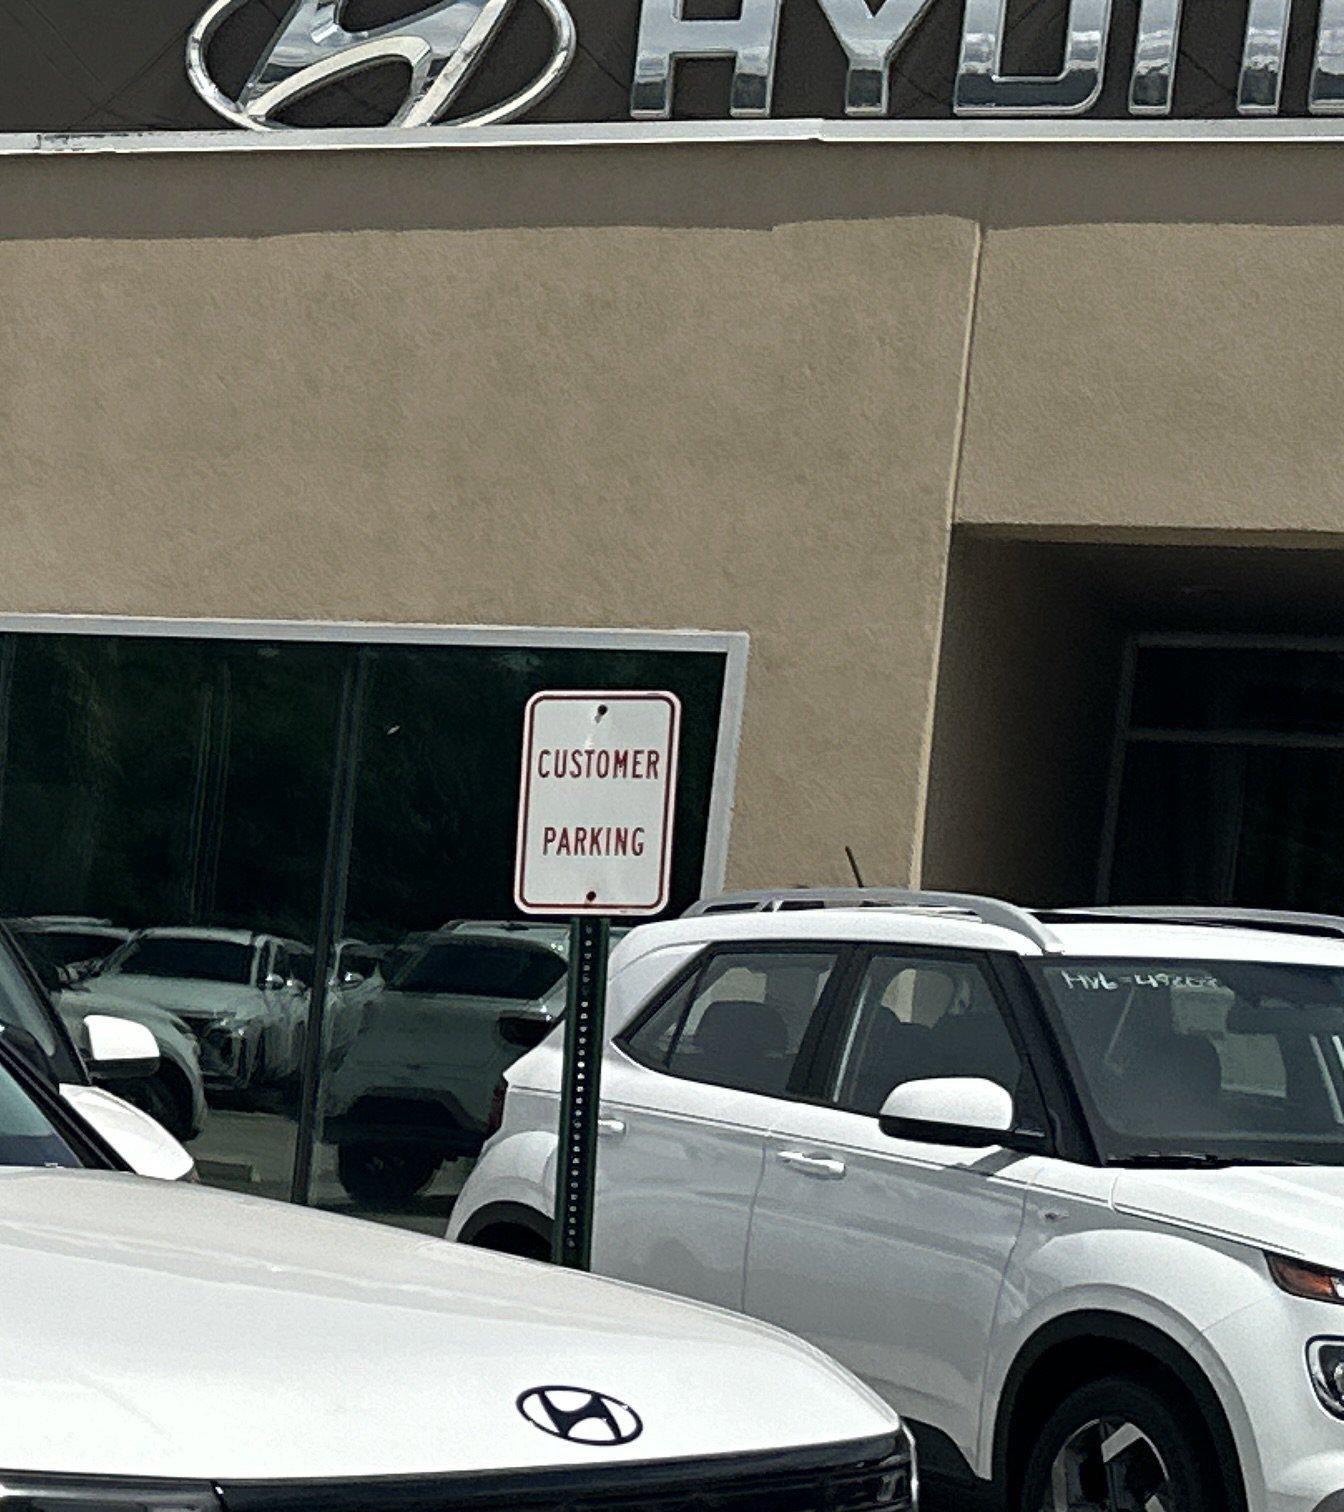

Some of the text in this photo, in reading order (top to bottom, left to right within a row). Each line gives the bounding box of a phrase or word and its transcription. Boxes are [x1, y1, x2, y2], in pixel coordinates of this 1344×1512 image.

[630, 0, 1344, 118] HYUN
[537, 748, 661, 780] CUSTOMER
[541, 826, 646, 857] PARKING
